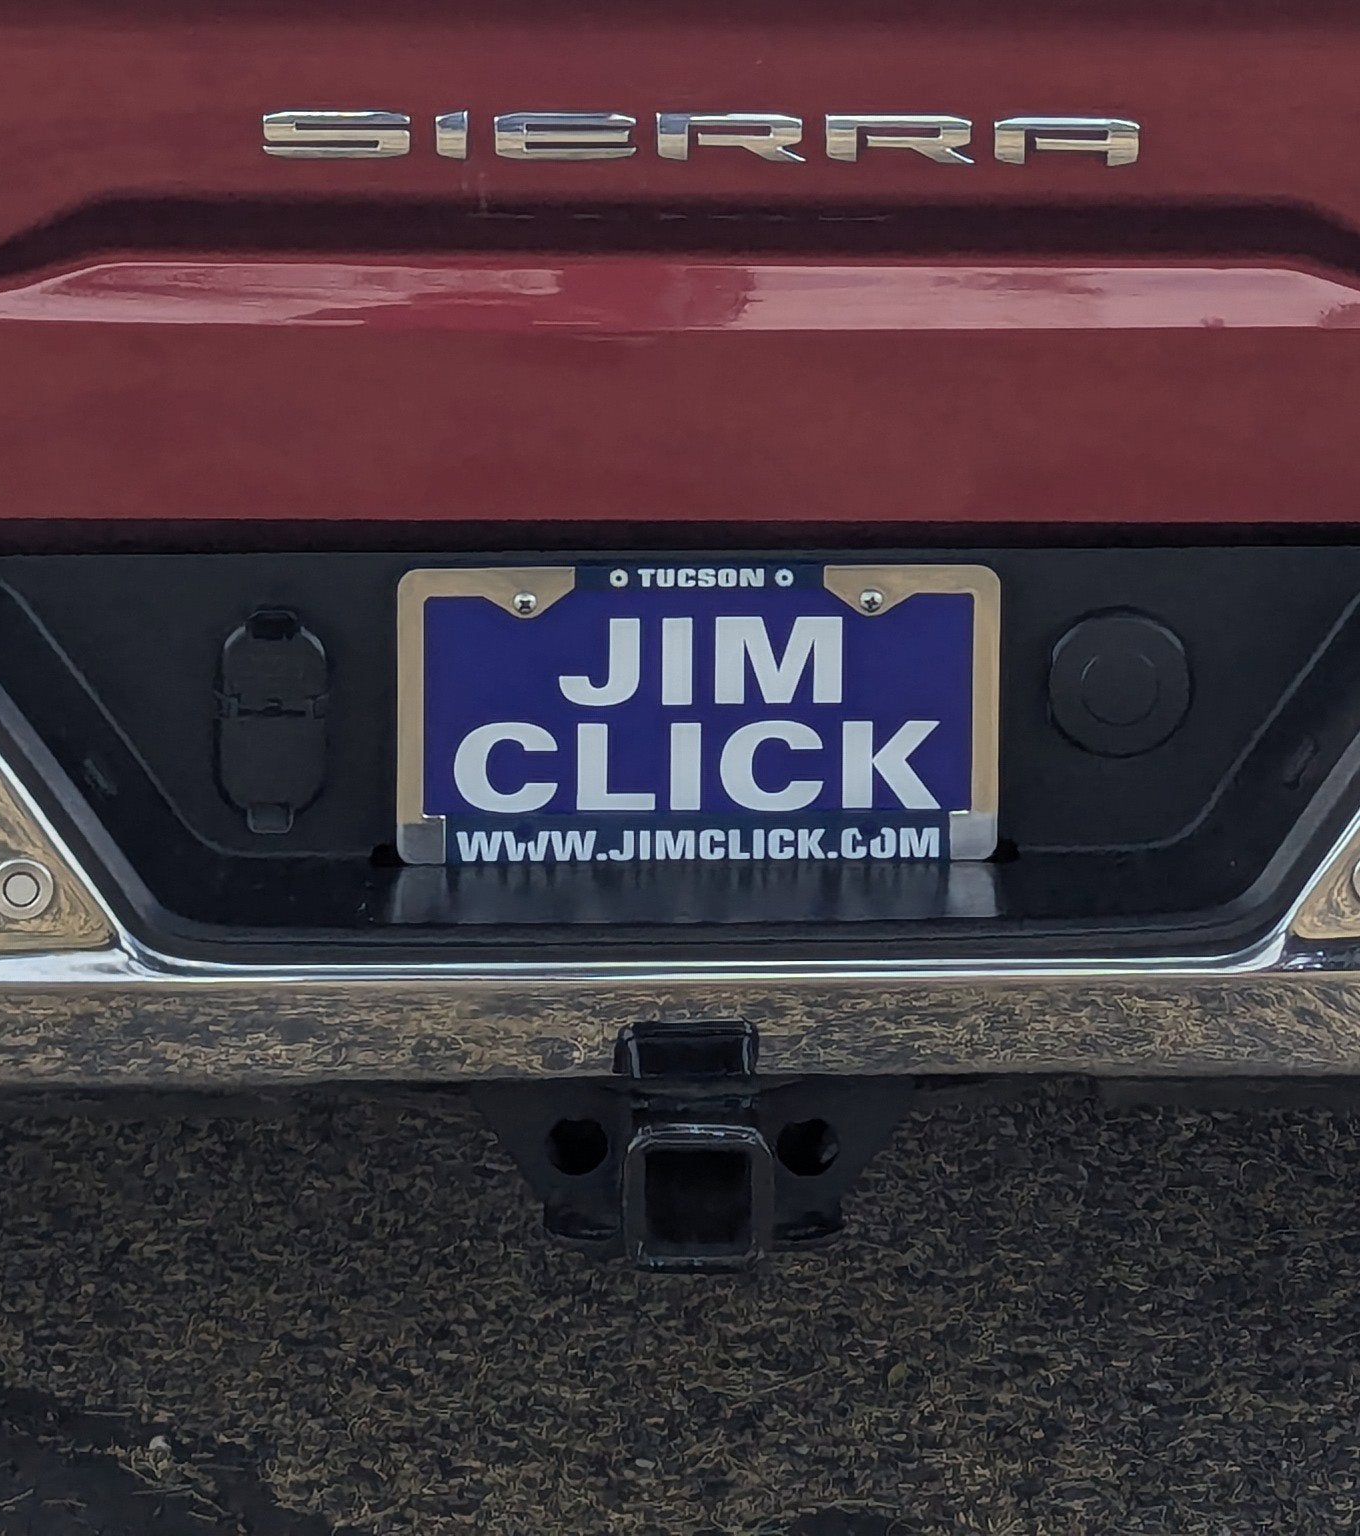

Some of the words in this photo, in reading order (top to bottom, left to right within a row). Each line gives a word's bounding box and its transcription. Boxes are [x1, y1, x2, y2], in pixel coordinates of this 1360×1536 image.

[261, 109, 1140, 168] SIERRA
[638, 567, 766, 589] TUCSON
[558, 615, 843, 707] JIM
[453, 719, 942, 813] CLICK
[456, 826, 941, 862] WWW.JIMCLICK.COM
